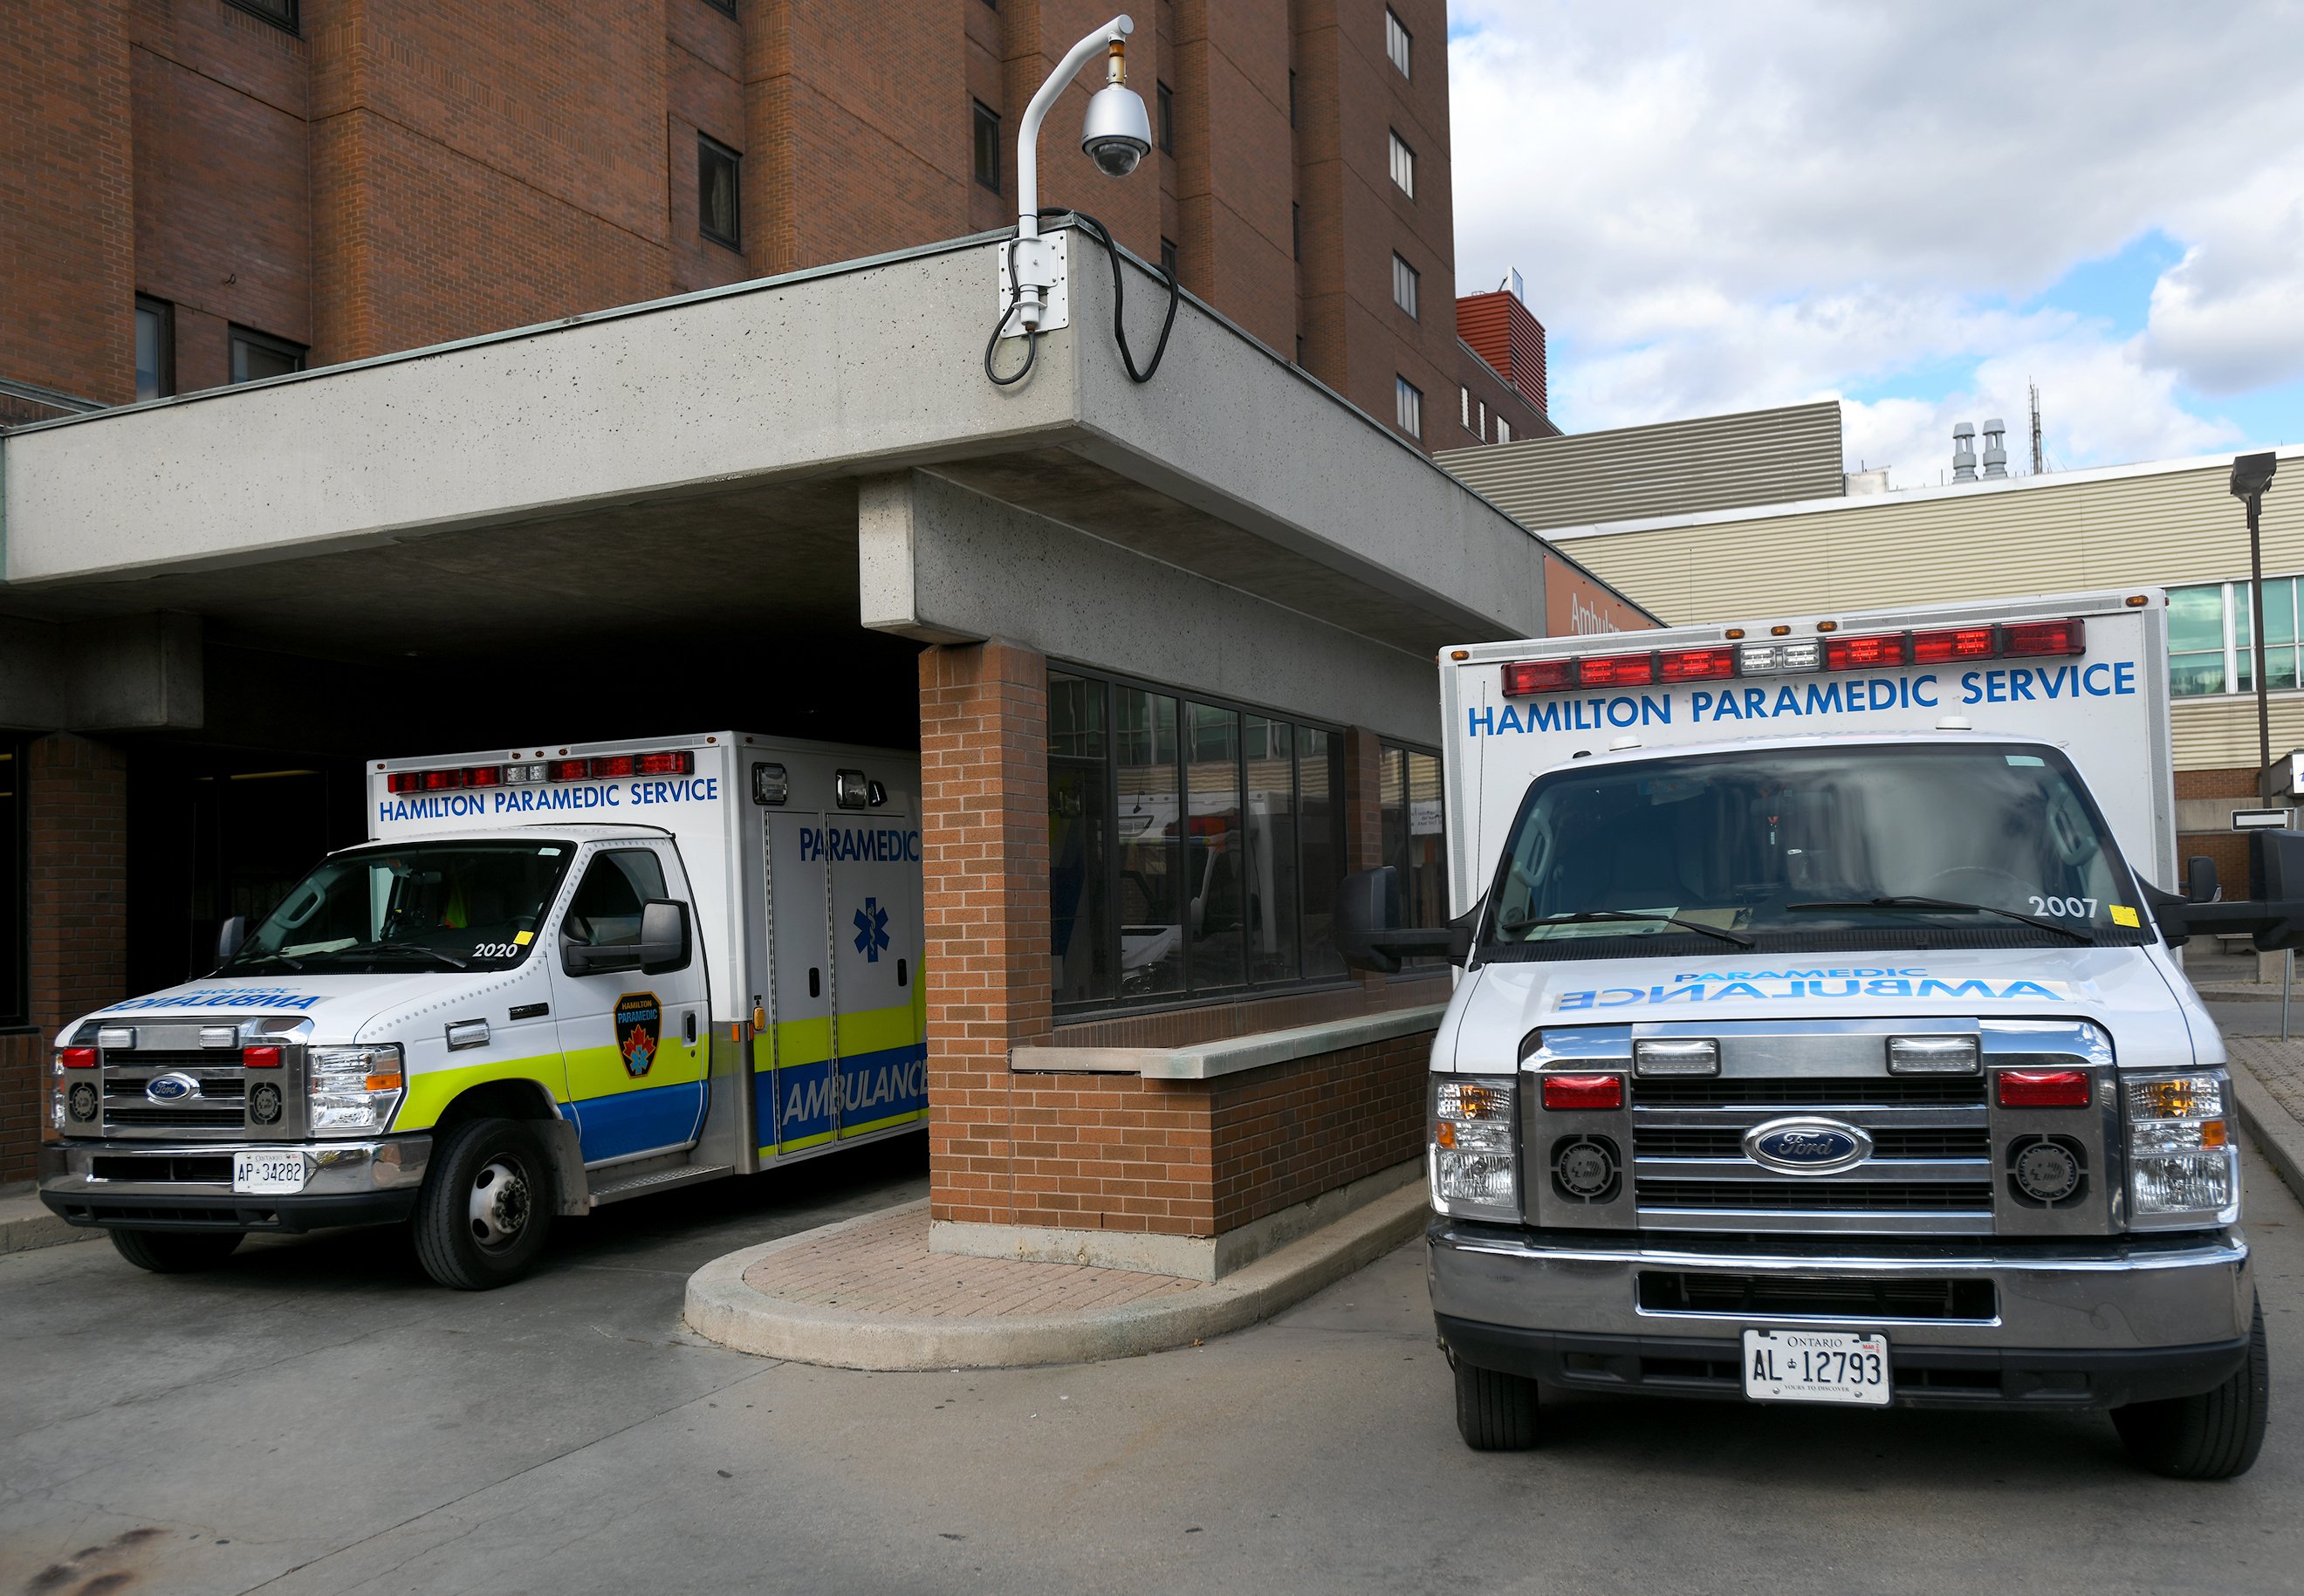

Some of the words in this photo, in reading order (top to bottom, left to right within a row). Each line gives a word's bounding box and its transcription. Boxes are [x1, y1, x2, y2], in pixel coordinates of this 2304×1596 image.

[1469, 694, 1671, 736] HAMILTON
[1692, 675, 1938, 723] PARAMEDIC
[1962, 661, 2136, 704] SERVICE
[380, 794, 484, 822] HAMILTON
[495, 784, 620, 813] PARAMEDIC
[631, 778, 717, 805] SERVICE
[799, 827, 919, 862] PARAMEDIC
[2028, 896, 2098, 919] 2007
[472, 943, 518, 957] 2020
[1675, 968, 1928, 983] PARAMEDIC
[622, 1000, 652, 1010] HAMILTON
[617, 1009, 658, 1024] PARAMEDIC
[155, 1081, 178, 1094] Ford
[1778, 1133, 1834, 1155] Ford
[238, 1163, 253, 1182] AP
[262, 1163, 302, 1182] 34282
[1787, 1336, 1842, 1349] ONTARIO
[1753, 1349, 1783, 1381] AL
[1803, 1351, 1881, 1385] 12793
